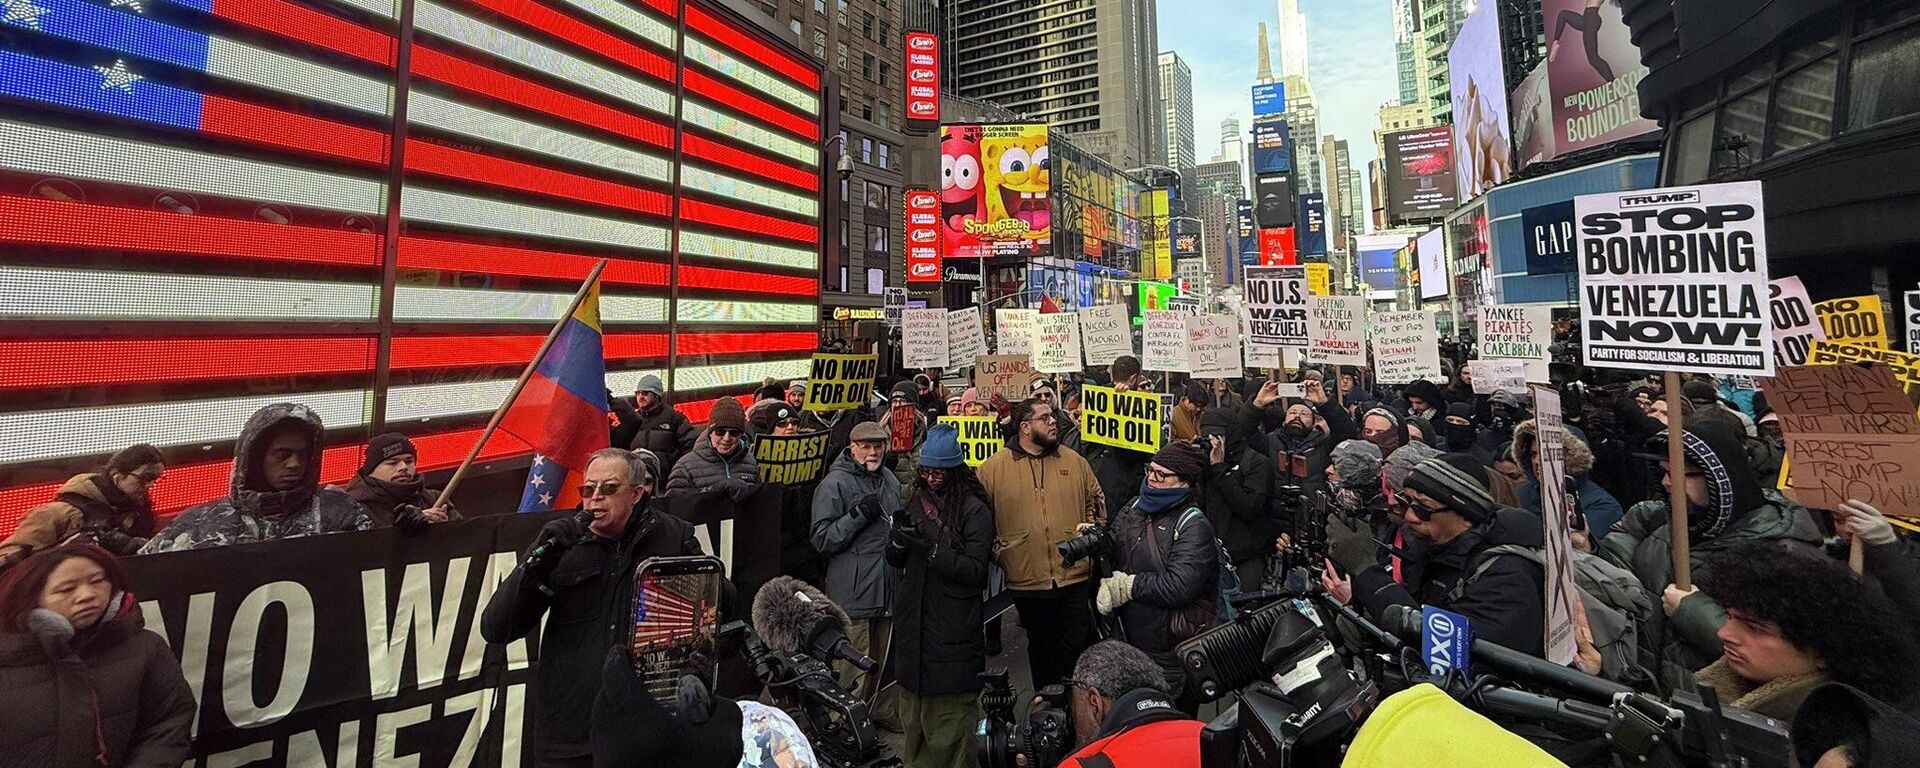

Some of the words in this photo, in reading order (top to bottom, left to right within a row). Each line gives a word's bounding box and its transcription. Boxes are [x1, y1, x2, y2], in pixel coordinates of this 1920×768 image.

[1564, 96, 1578, 108] NEW
[1622, 193, 1697, 206] TRUMP:
[1582, 204, 1754, 235] STOP
[1534, 221, 1572, 256] GAP
[1584, 231, 1756, 275] BOMBING
[886, 294, 905, 305] BLOOD
[1247, 280, 1269, 304] NO
[1272, 280, 1306, 305] U.S.
[1317, 298, 1345, 308] DEFEND
[1586, 284, 1761, 319] VENEZUELA
[1814, 300, 1859, 314] NO
[1053, 315, 1075, 324] STREET
[1089, 308, 1113, 317] FREE
[1249, 308, 1307, 320] WAR
[1313, 308, 1352, 320] VENEZUELA
[1379, 312, 1424, 323] REMEMBER
[1484, 308, 1524, 320] YANKEE
[1086, 320, 1119, 331] NICOLAS
[1250, 320, 1308, 337] VENEZUELA
[1319, 320, 1352, 331] AGAINST
[1485, 321, 1533, 334] PIRATES
[1041, 334, 1059, 343] HANDS
[1087, 333, 1125, 345] MADURO!
[1380, 335, 1423, 345] REMEMBER
[1485, 334, 1501, 343] OUT
[1503, 334, 1513, 343] OF
[1516, 334, 1531, 343] THE
[1589, 320, 1762, 347] NOW!
[1189, 342, 1233, 352] VENEZUELAN
[1379, 347, 1416, 355] VIETNAM!
[1484, 343, 1542, 357] CARIBBEAN
[1815, 341, 1920, 366] MONEY
[1199, 351, 1218, 363] OIL!
[1591, 347, 1619, 360] PARTY
[1619, 349, 1638, 360] FOR
[1637, 350, 1685, 363] SOCIALISM
[1687, 352, 1700, 363] &
[1701, 352, 1761, 366] LIBERATION
[812, 358, 838, 380] NO
[841, 358, 876, 380] WAR
[982, 361, 998, 374] US
[1000, 361, 1029, 373] HANDS
[993, 374, 1013, 385] OFF
[1766, 366, 1820, 390] WE
[810, 383, 845, 404] FOR
[846, 383, 872, 403] OIL
[977, 385, 1029, 399] VENEZUELA
[1084, 390, 1109, 413] NO
[1112, 393, 1158, 421] WAR
[1777, 390, 1910, 414] PEACE
[964, 421, 1003, 439] WAR
[1087, 414, 1119, 440] FOR
[1125, 422, 1154, 446] OIL
[1784, 413, 1822, 433] NOT
[756, 434, 828, 461] ARREST
[1793, 440, 1891, 461] ARREST
[758, 458, 822, 485] TRUMP
[1800, 461, 1903, 485] TRUMP
[138, 580, 316, 738] NO
[361, 550, 530, 701] WA
